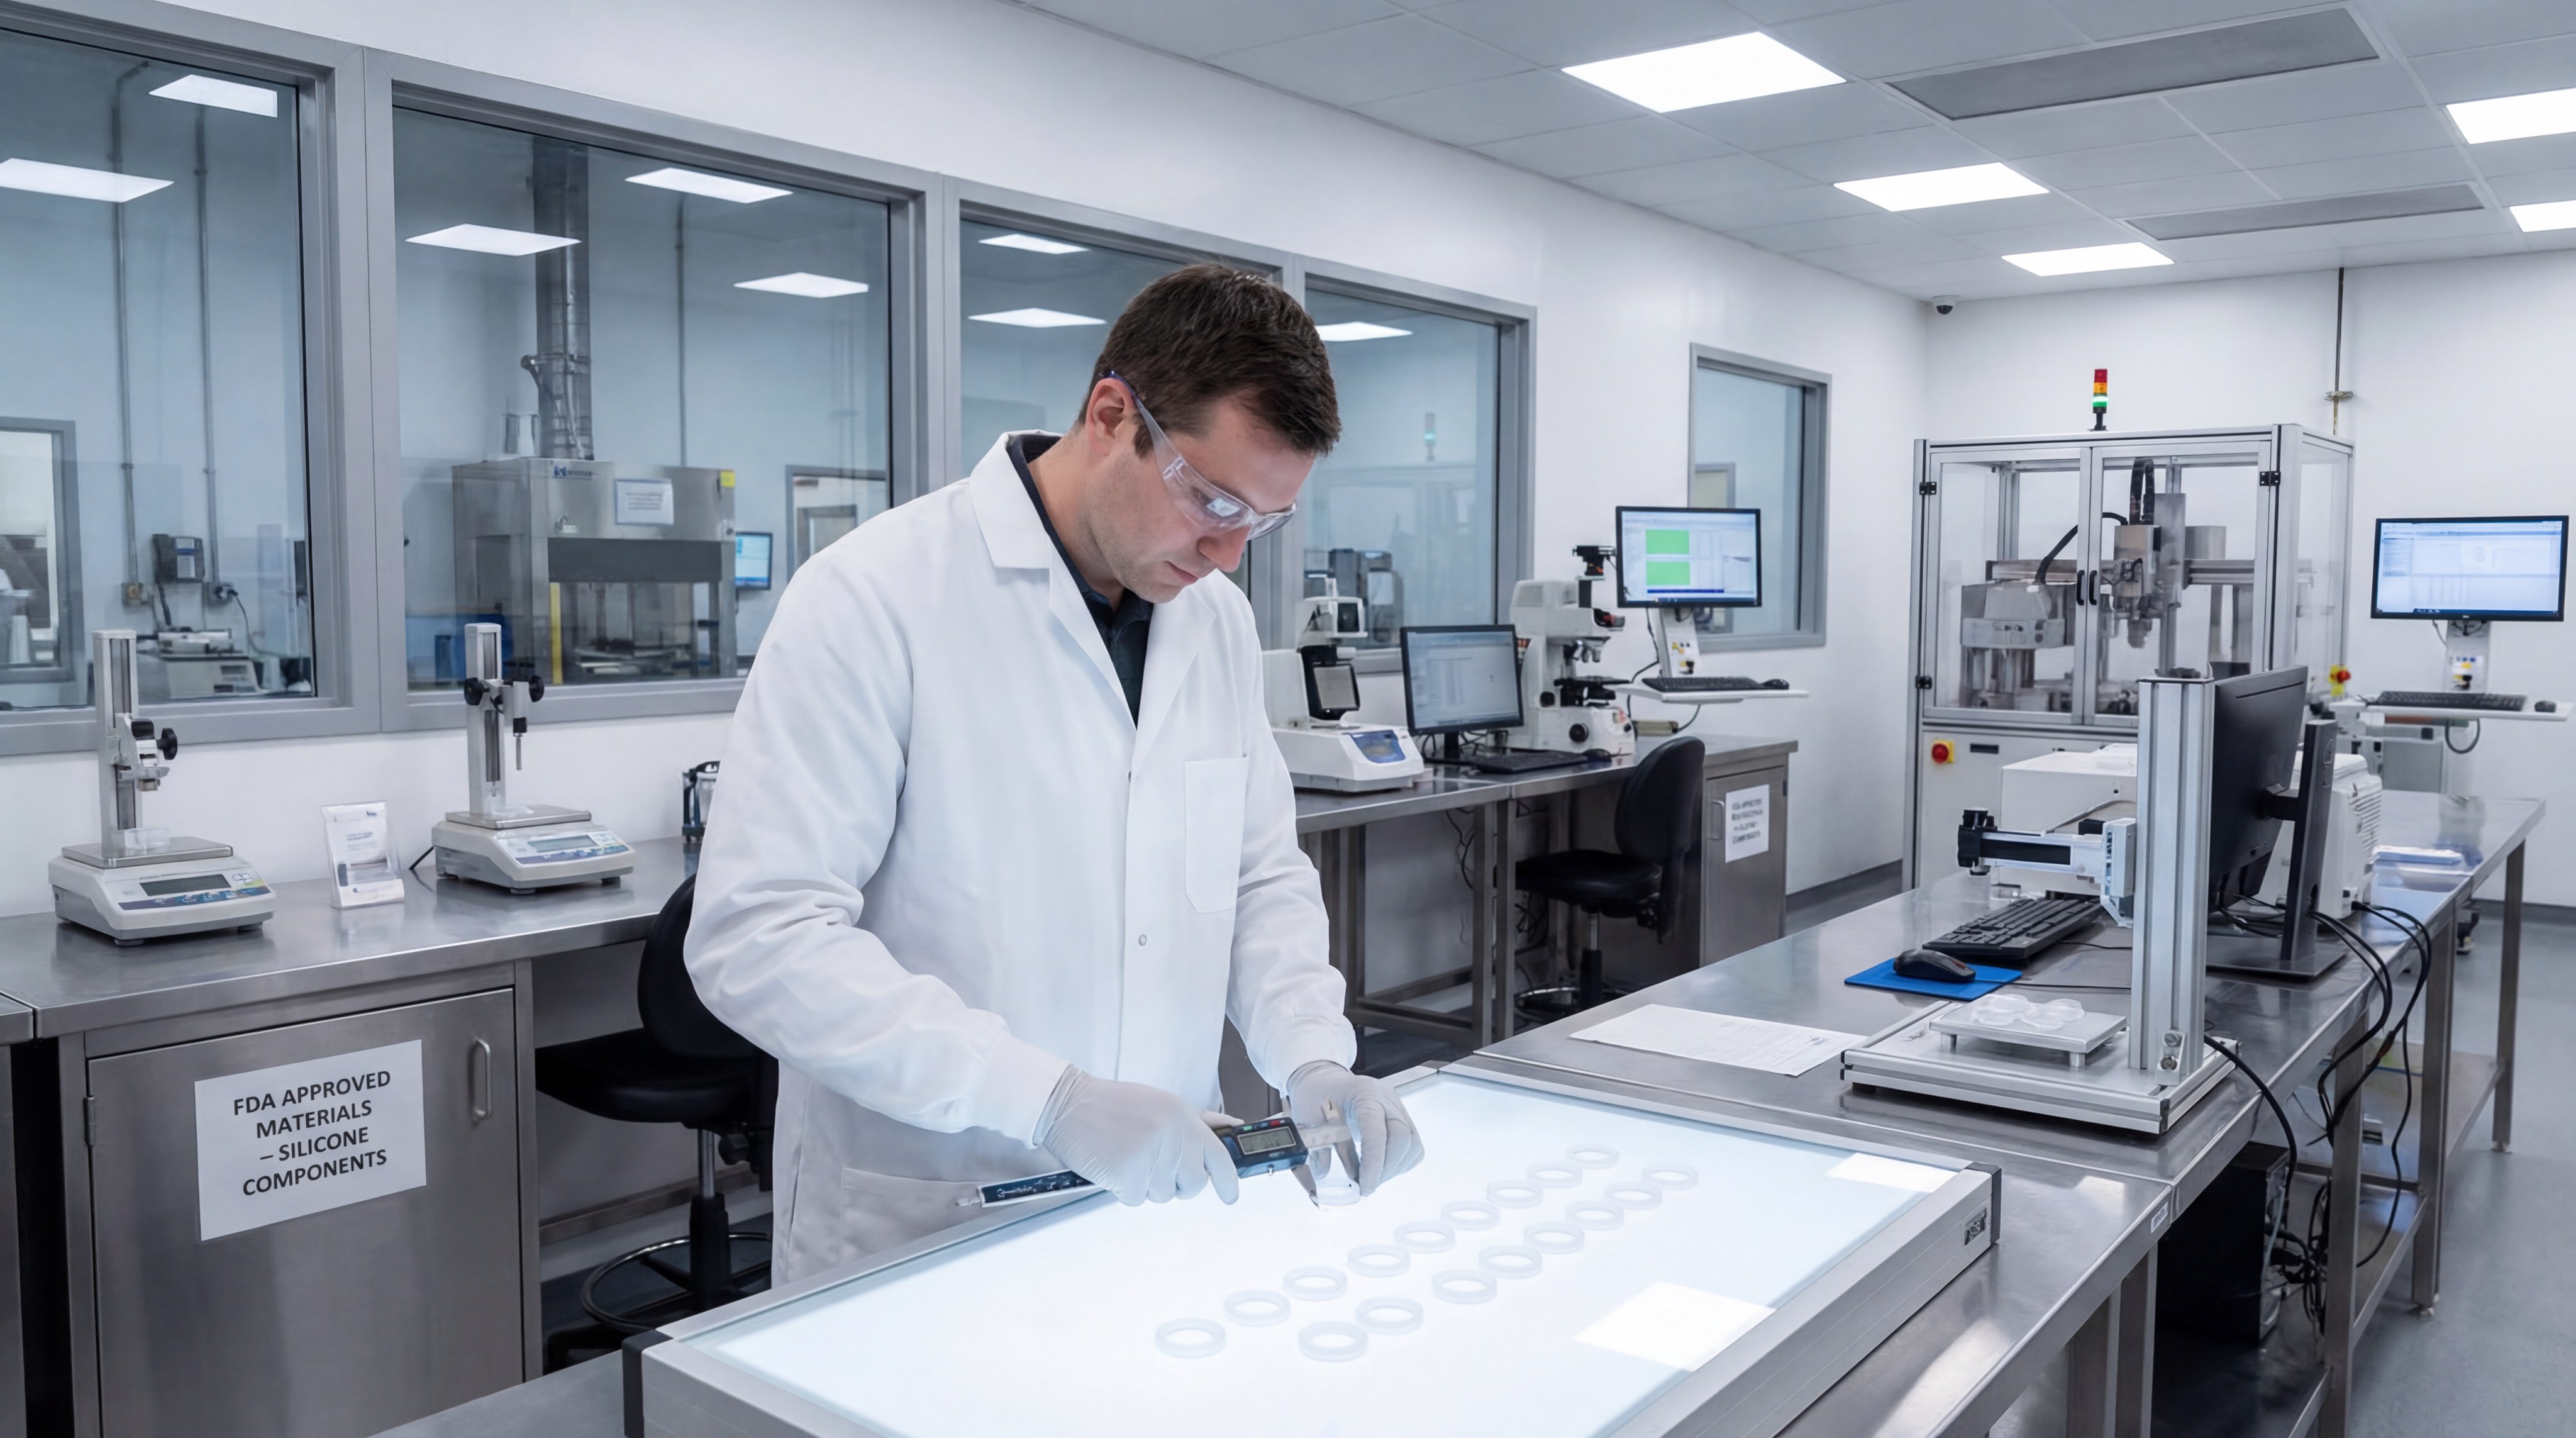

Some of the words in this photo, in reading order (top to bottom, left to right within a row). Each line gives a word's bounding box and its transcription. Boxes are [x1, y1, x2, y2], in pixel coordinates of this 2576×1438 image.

[233, 1093, 277, 1116] FDA
[281, 1069, 391, 1107] APPROVED
[256, 1100, 372, 1139] MATERIALS
[279, 1127, 369, 1161] SILICONE
[243, 1149, 387, 1196] COMPONENTS
